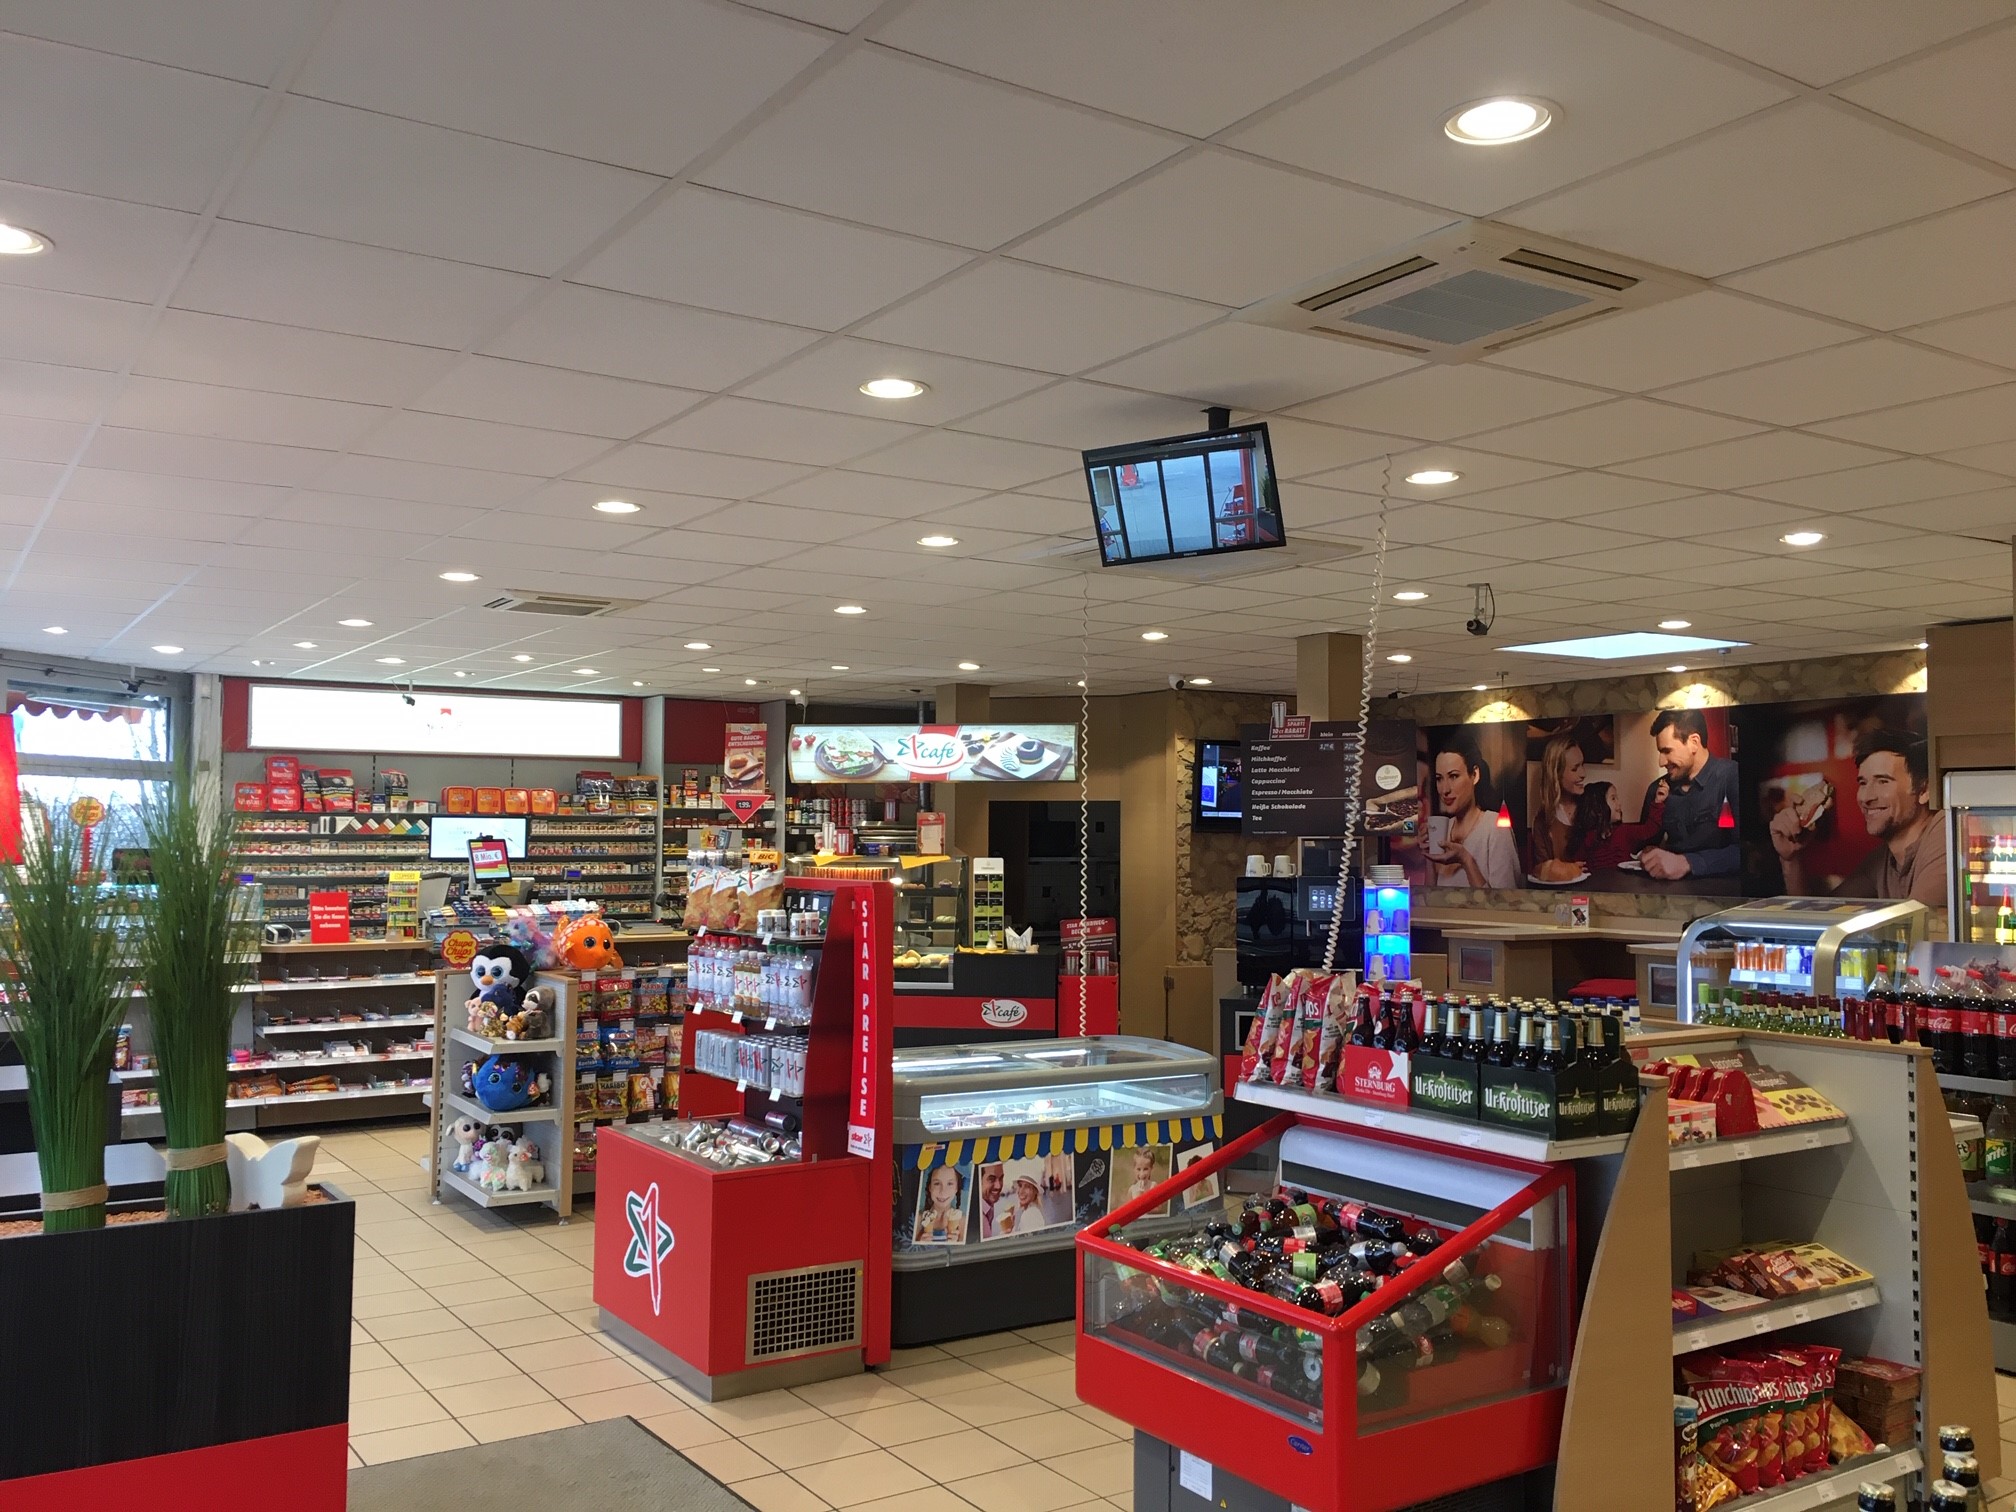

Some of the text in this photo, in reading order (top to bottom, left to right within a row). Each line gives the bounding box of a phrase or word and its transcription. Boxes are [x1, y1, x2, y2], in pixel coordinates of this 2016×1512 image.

[921, 741, 955, 765] café
[448, 938, 474, 947] Chupa
[861, 900, 870, 980] STAR
[446, 947, 472, 955] Chups
[998, 1006, 1020, 1021] café
[859, 993, 870, 1117] PREISE
[1355, 1076, 1395, 1093] STERNBURG
[851, 1132, 863, 1142] star
[1710, 1418, 1729, 1430] Paprika
